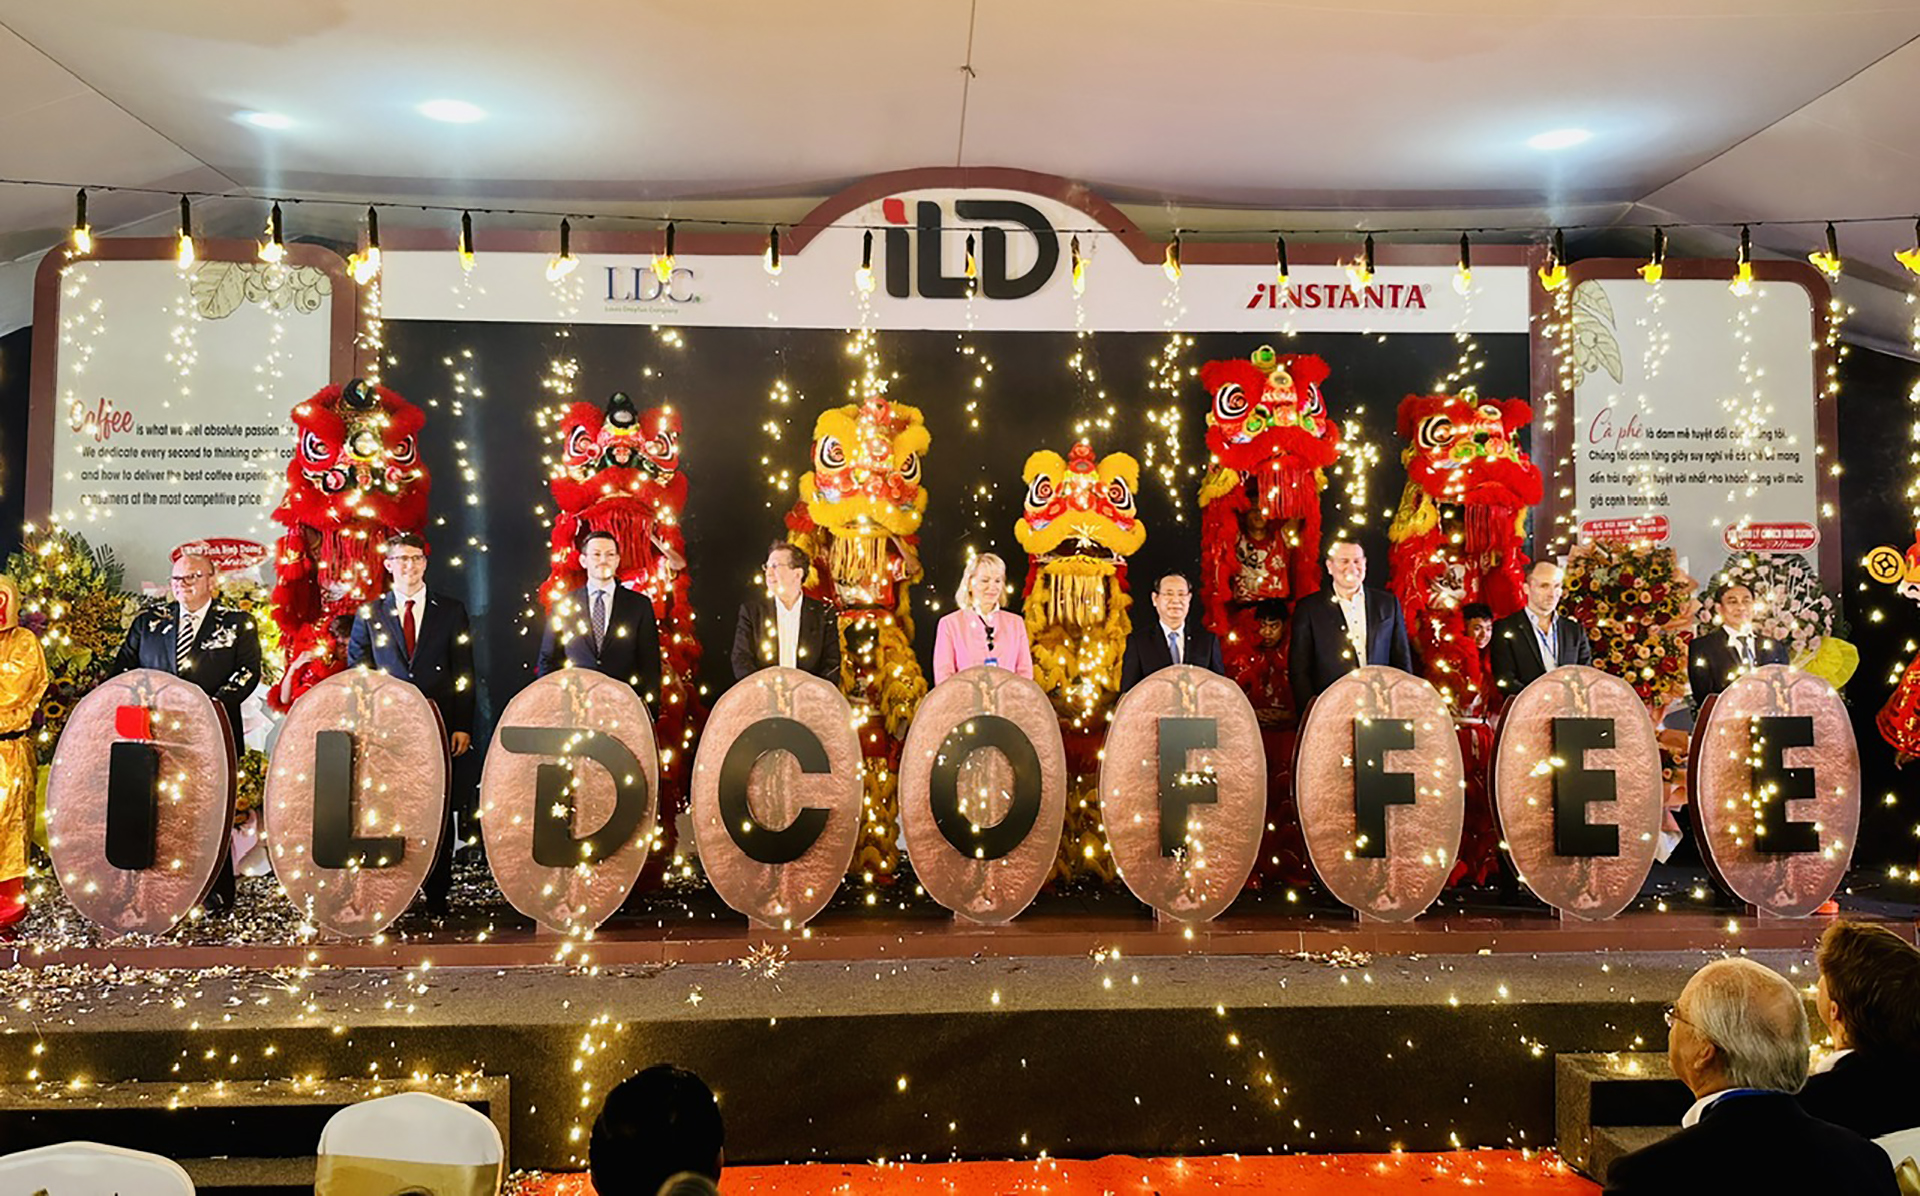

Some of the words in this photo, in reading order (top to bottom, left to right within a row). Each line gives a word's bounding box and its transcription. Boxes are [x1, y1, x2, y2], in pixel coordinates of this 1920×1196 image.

[136, 424, 144, 436] is
[146, 424, 168, 436] what
[204, 423, 243, 436] absolute
[245, 425, 280, 438] passion
[98, 447, 138, 458] dedicate
[141, 449, 166, 460] every
[168, 447, 200, 458] second
[203, 447, 212, 458] to
[214, 447, 250, 460] thinking
[1690, 453, 1703, 463] suy
[1777, 452, 1799, 464] mang
[81, 469, 99, 480] and
[101, 469, 120, 480] how
[123, 469, 132, 480] to
[134, 469, 165, 480] deliver
[167, 469, 181, 481] the
[183, 469, 203, 481] best
[205, 469, 233, 481] coffee
[235, 470, 285, 482] experiee
[131, 491, 141, 504] at
[143, 491, 157, 504] the
[159, 492, 181, 504] most
[183, 491, 237, 507] competitive
